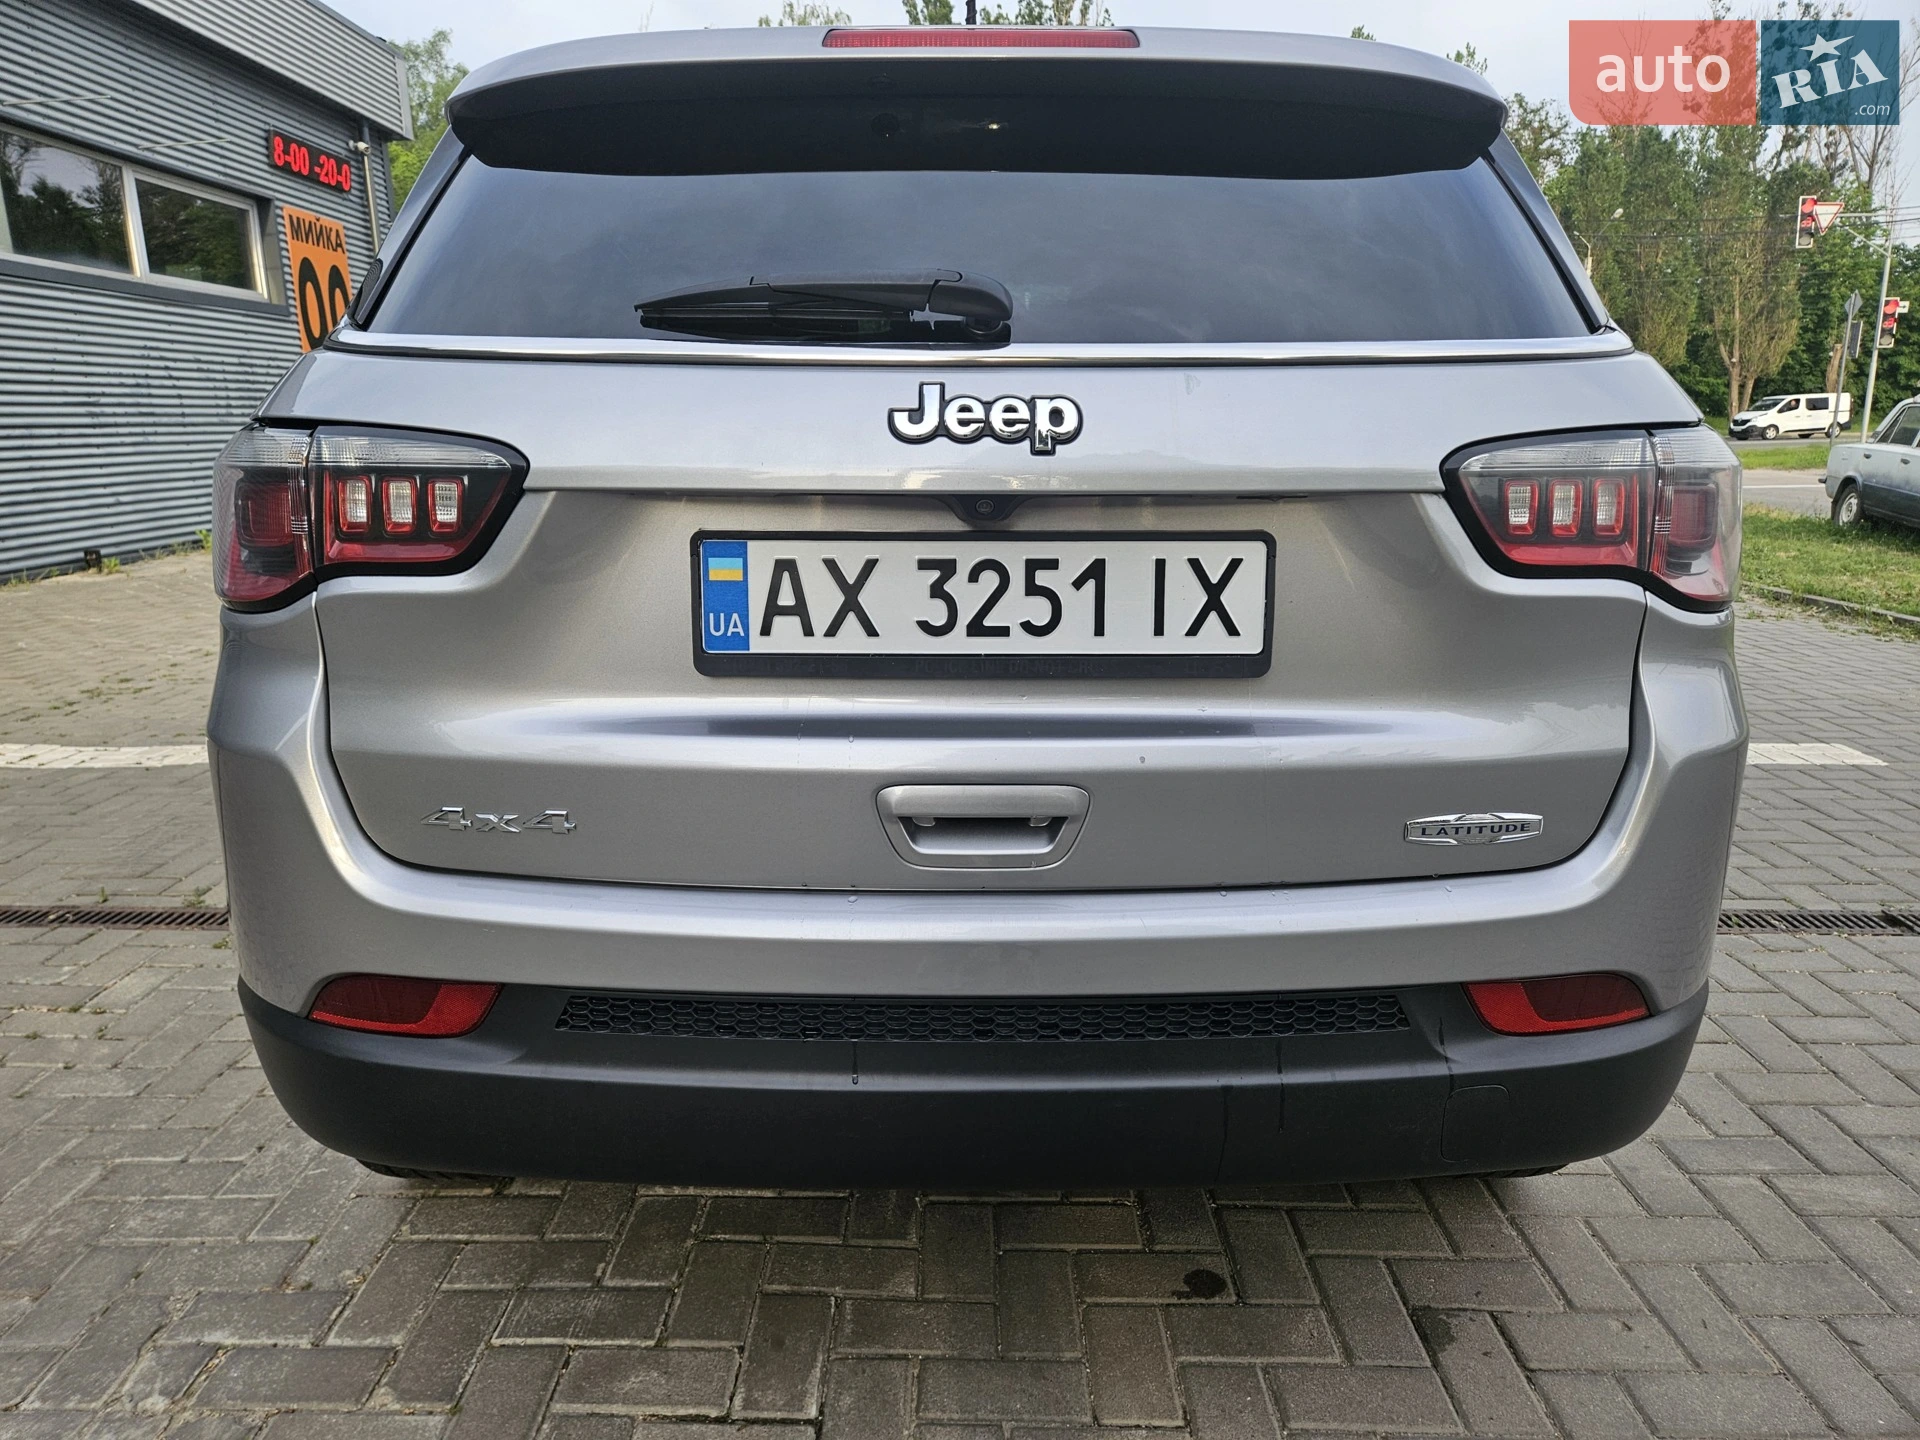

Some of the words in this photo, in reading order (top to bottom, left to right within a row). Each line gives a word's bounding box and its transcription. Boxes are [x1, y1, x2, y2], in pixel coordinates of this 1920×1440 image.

[273, 135, 310, 176] 8-00
[288, 214, 345, 254] МИЙКА
[888, 381, 1083, 456] Jeep
[759, 557, 880, 638] AX
[915, 557, 1107, 638] 3251
[1153, 557, 1245, 638] IX
[708, 612, 745, 638] UA
[420, 806, 577, 835] 4x4
[1421, 822, 1531, 837] LATITUDE
